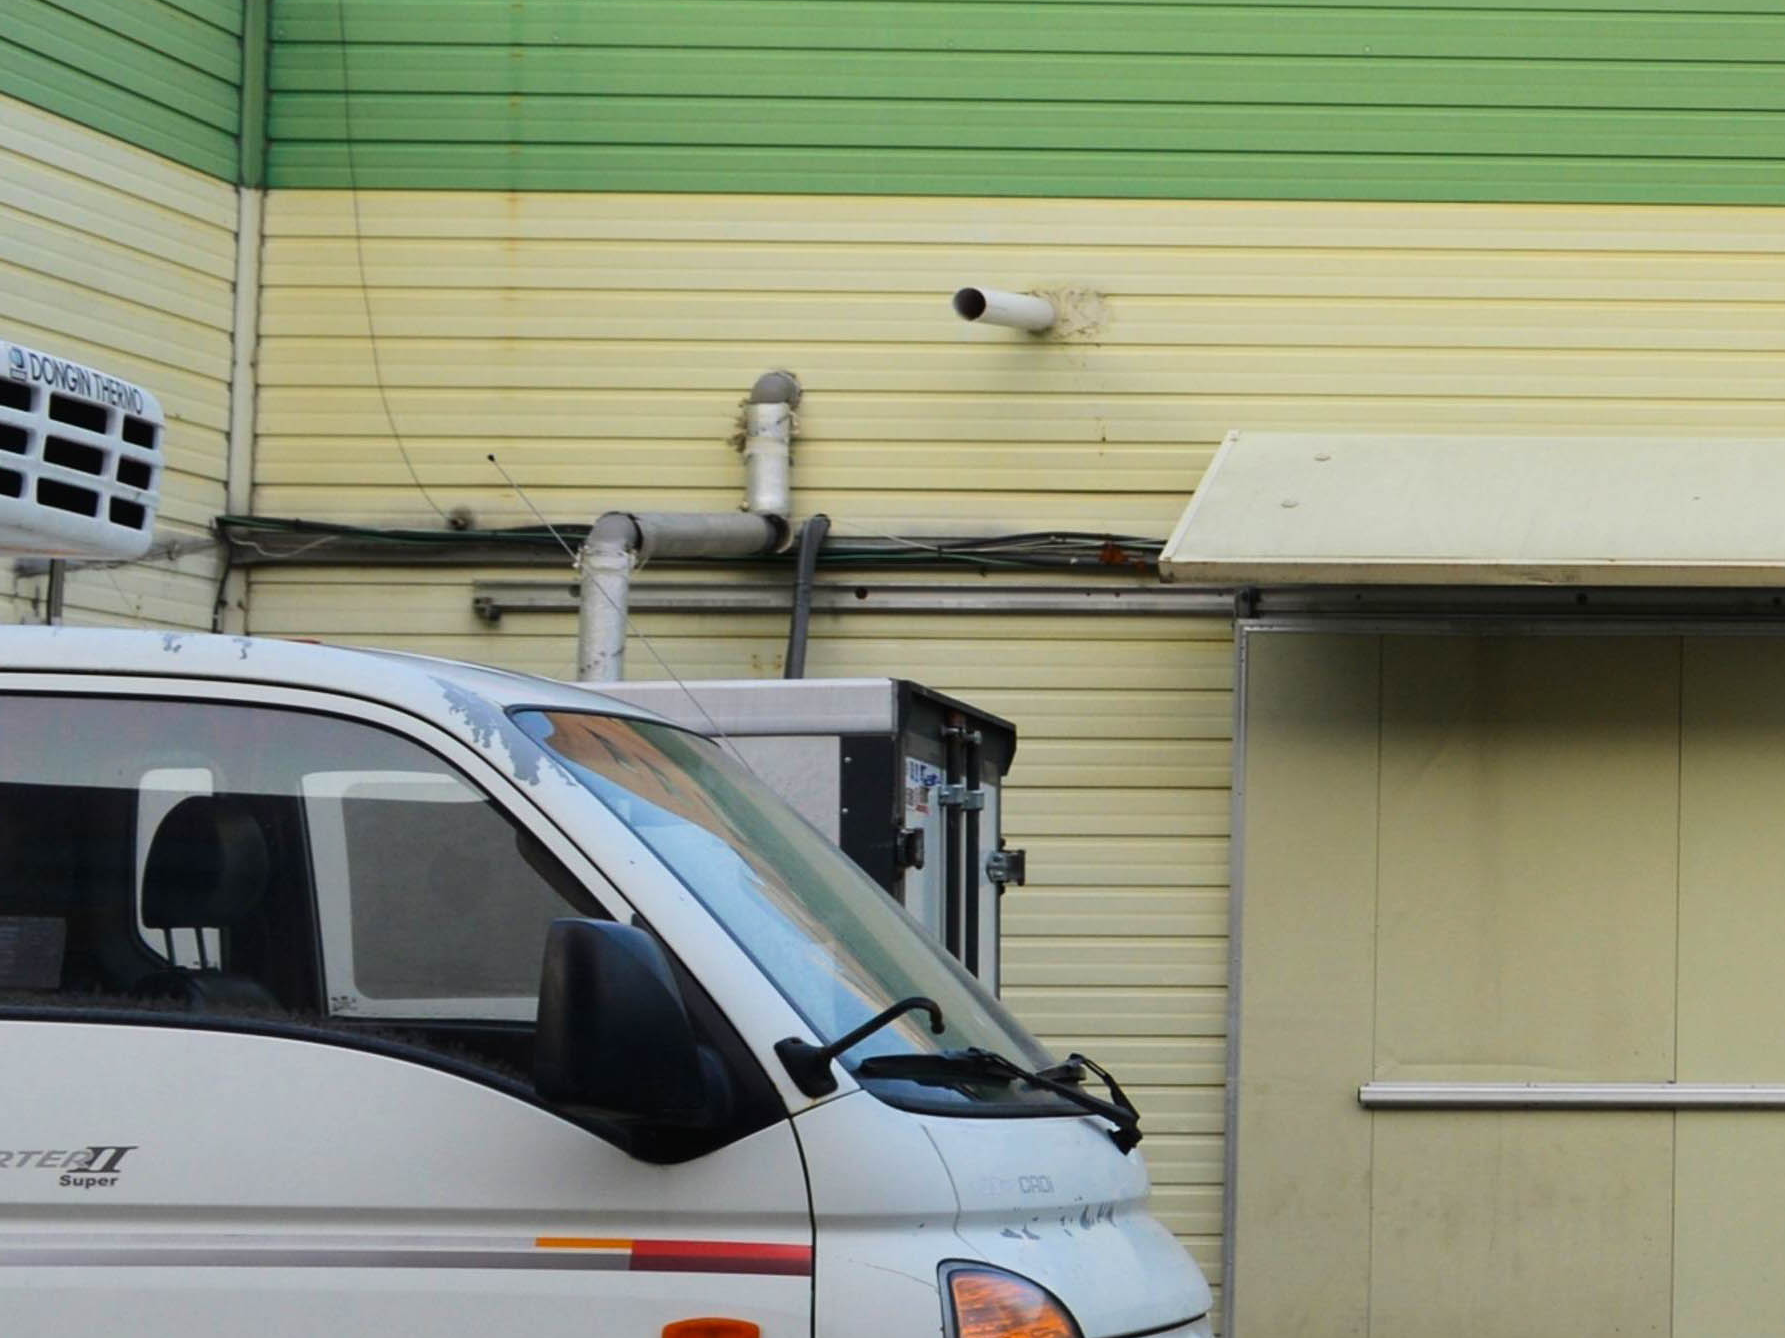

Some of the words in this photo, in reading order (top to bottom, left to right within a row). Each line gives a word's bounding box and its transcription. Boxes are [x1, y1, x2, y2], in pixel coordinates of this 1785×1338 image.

[28, 351, 91, 398] DONGIN
[93, 372, 144, 415] THERMO
[59, 1174, 118, 1188] Super
